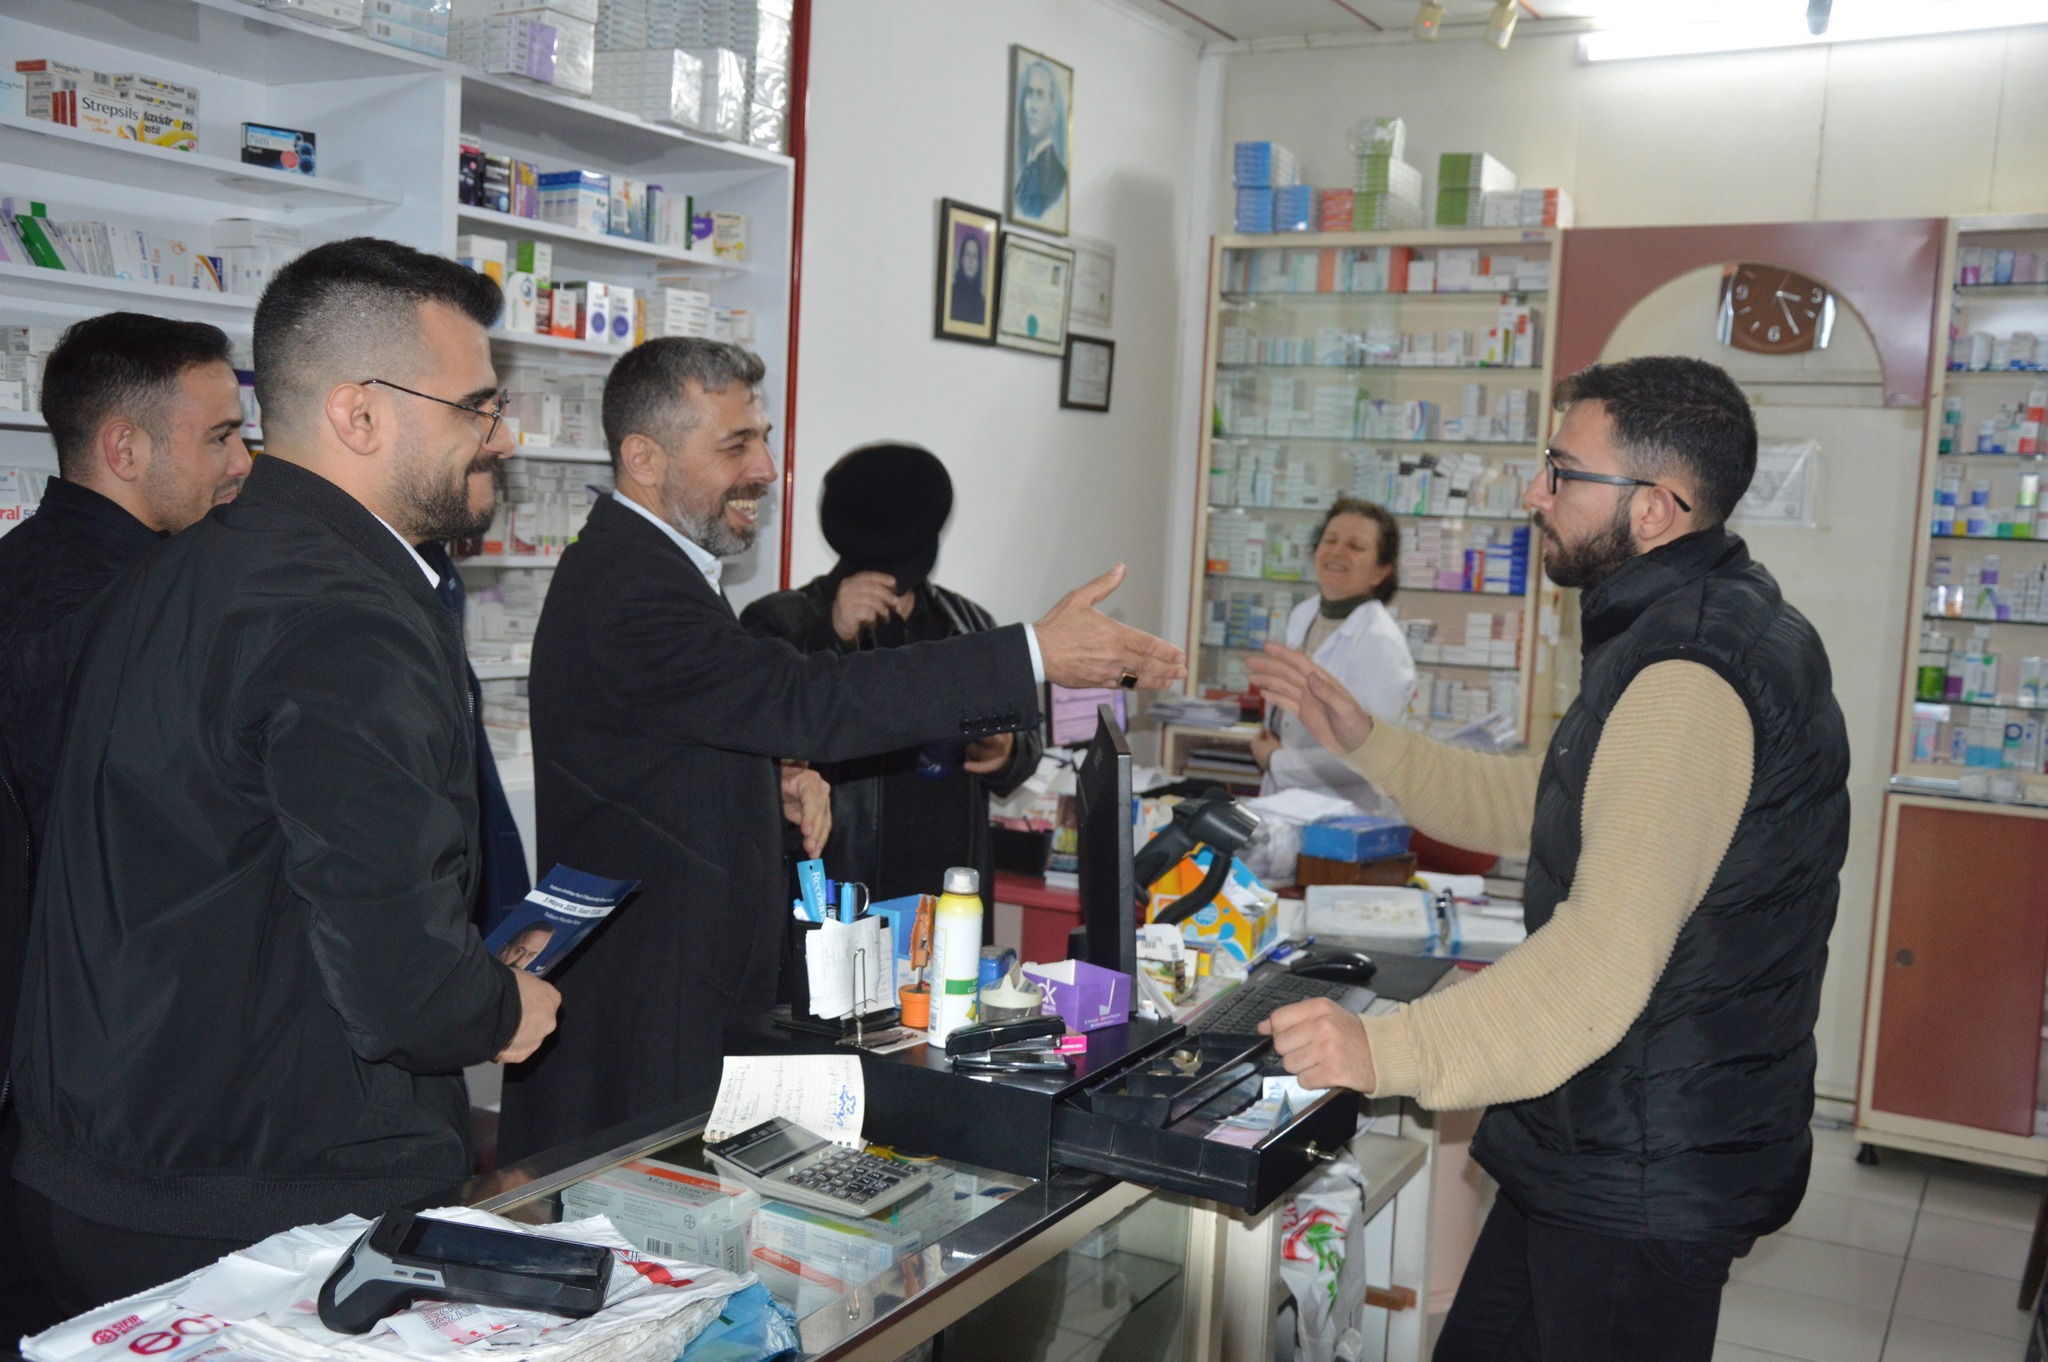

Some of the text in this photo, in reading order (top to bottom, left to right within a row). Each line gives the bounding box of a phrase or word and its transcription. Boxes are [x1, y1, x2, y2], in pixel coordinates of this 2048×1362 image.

[52, 61, 81, 74] Strepsils
[82, 97, 139, 120] Strepsils
[144, 124, 160, 134] astil
[1811, 287, 1823, 304] 3
[1767, 325, 1780, 342] 6
[112, 1314, 142, 1332] SIFIR
